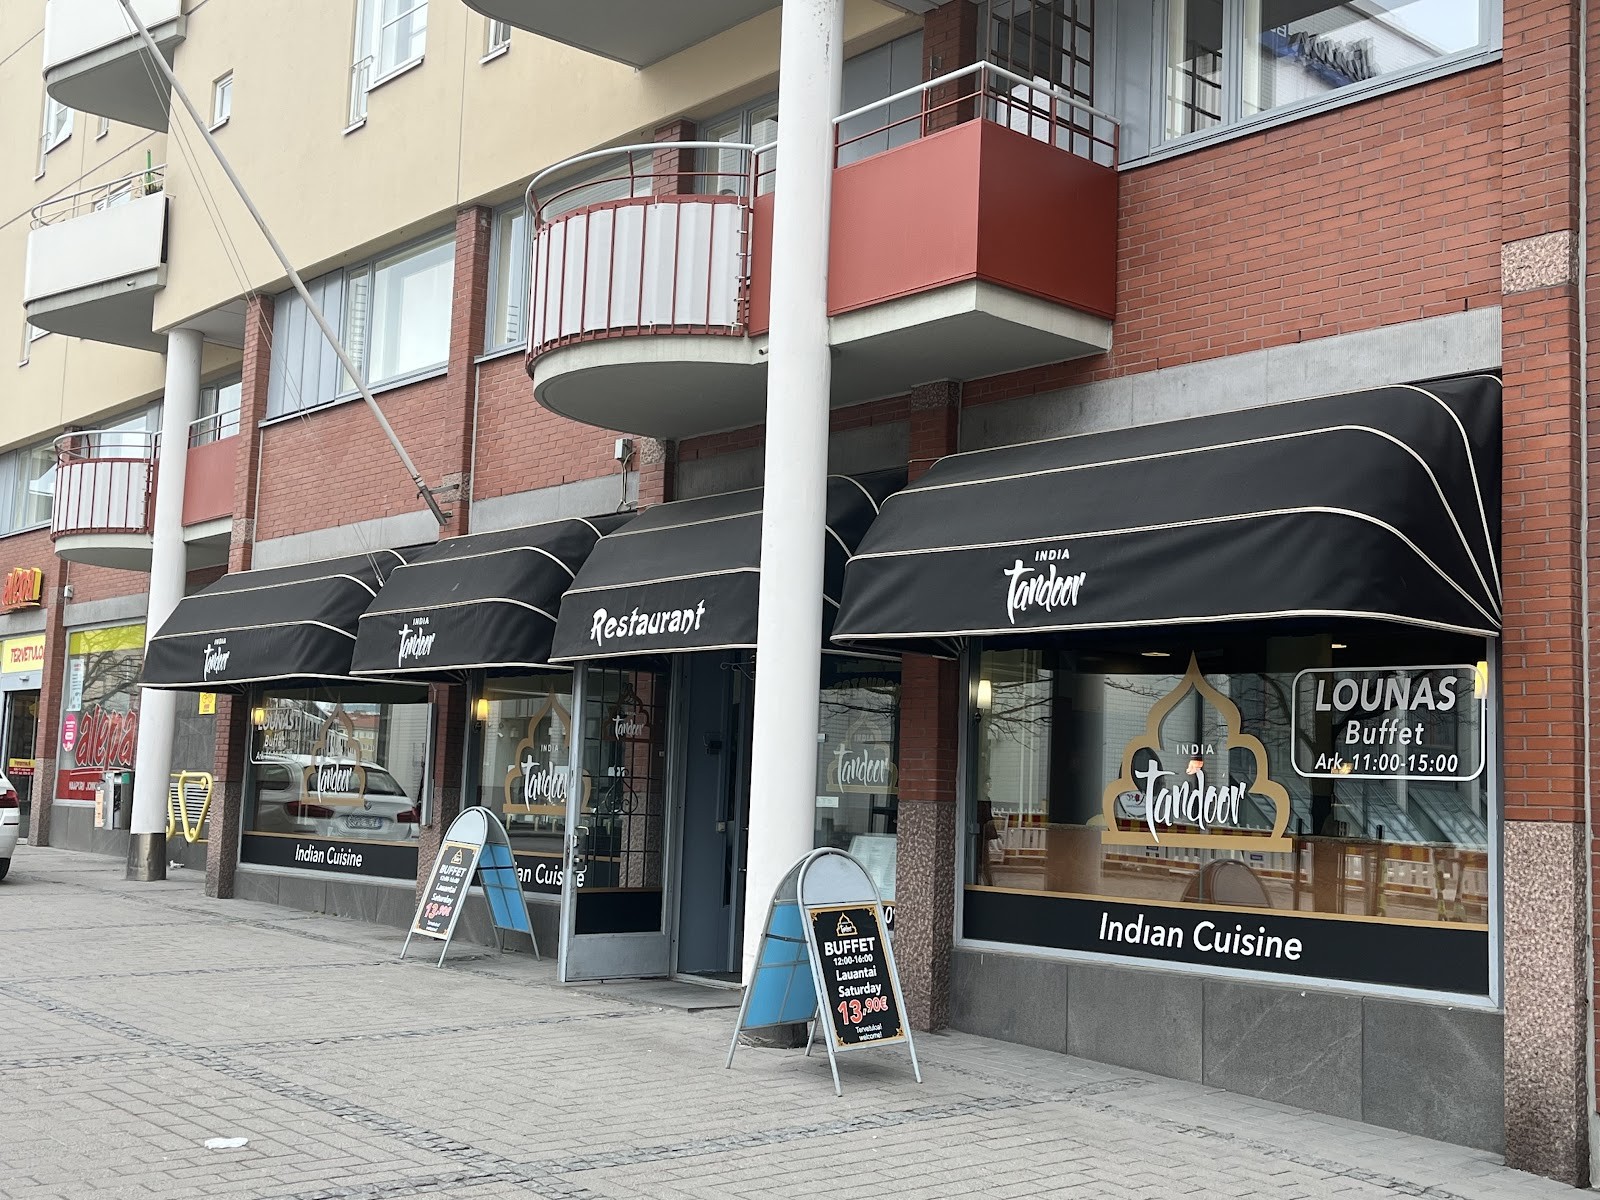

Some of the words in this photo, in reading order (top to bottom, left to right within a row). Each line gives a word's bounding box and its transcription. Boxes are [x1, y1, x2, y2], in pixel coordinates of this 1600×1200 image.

[1034, 548, 1070, 561] INDIA
[412, 616, 430, 626] INDIA
[590, 599, 706, 647] Restaurant
[1315, 675, 1458, 712] LOUNAS
[1345, 718, 1425, 746] Buffet
[540, 744, 559, 752] INDIA
[1175, 744, 1215, 756] INDIA
[1352, 753, 1459, 773] 11:00-15:00
[295, 844, 325, 864] Indian
[326, 846, 363, 868] Cuisine
[535, 863, 585, 888] Cuise
[824, 936, 876, 957] BUFFET
[1099, 911, 1184, 949] Indian
[1192, 919, 1303, 961] Cuisine
[836, 965, 878, 982] Lauantai
[838, 981, 882, 998] Saturday
[837, 996, 889, 1025] 13,90€
